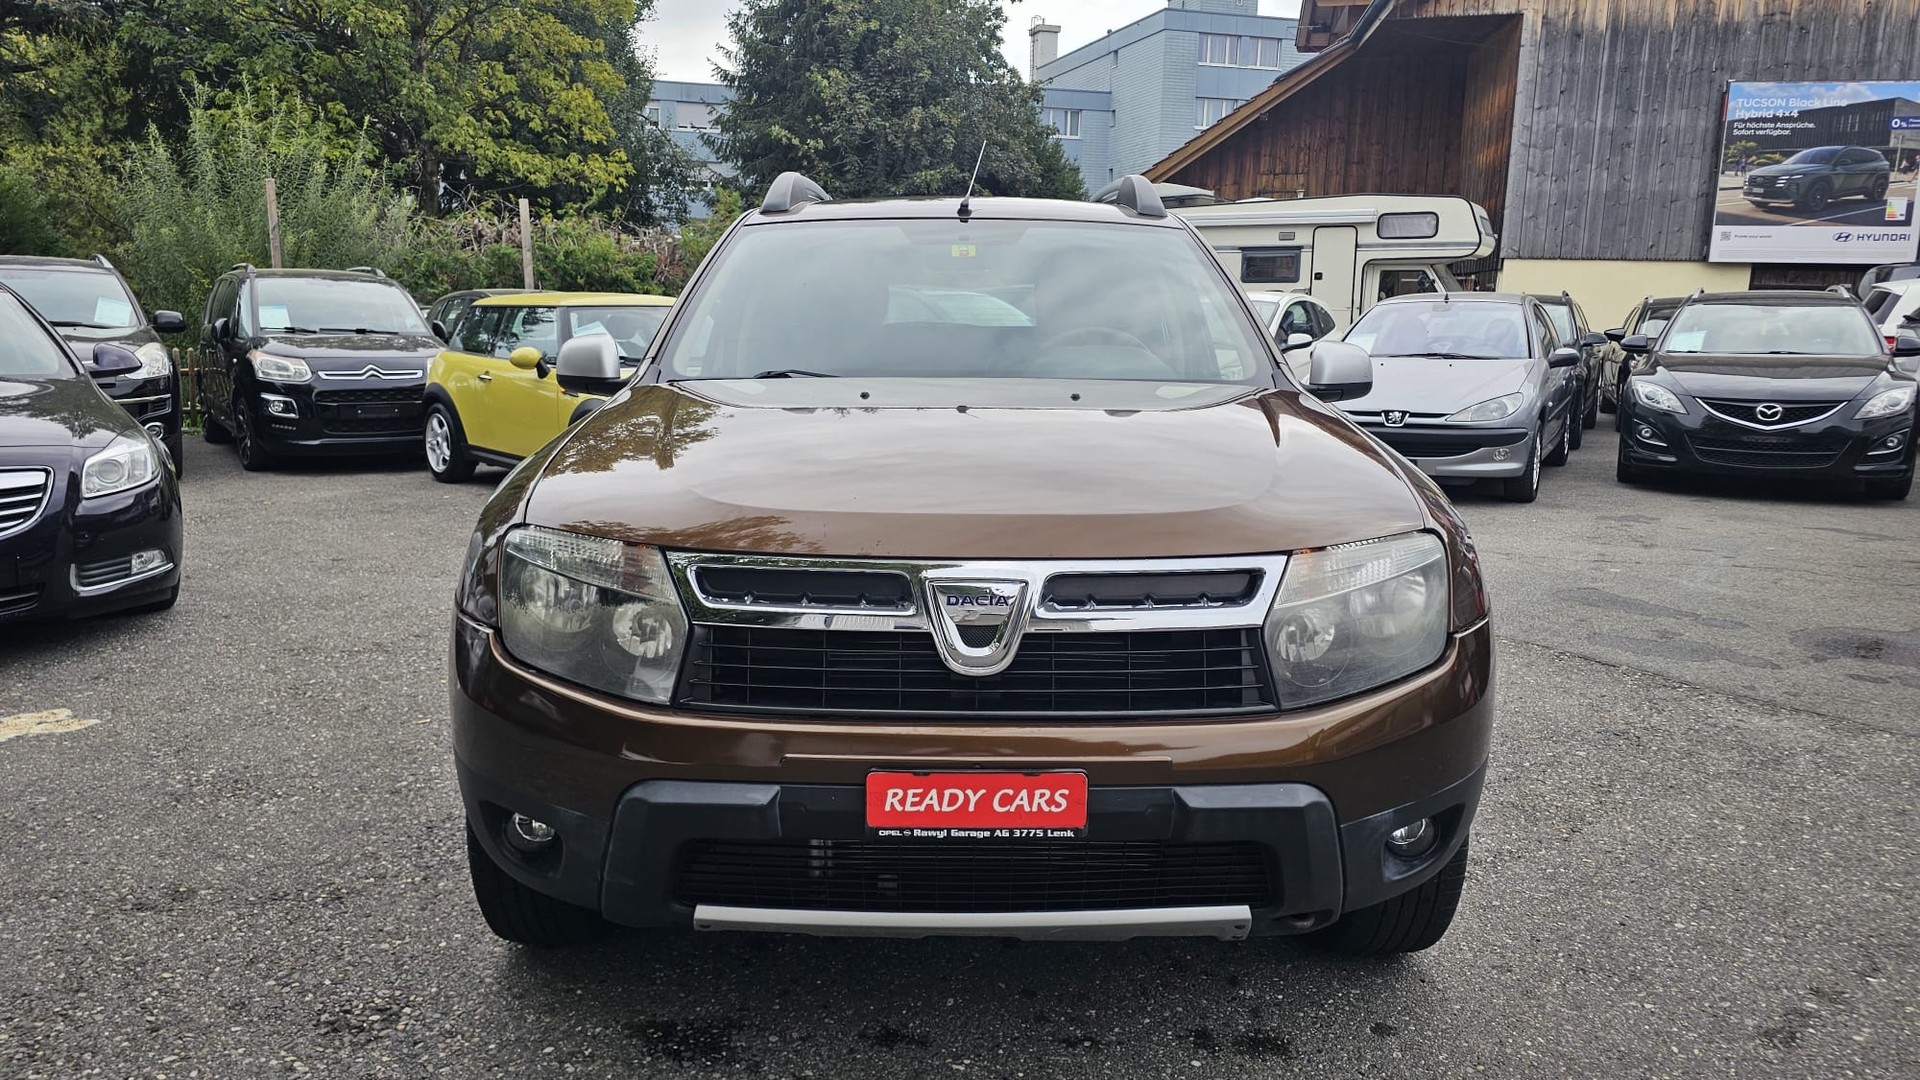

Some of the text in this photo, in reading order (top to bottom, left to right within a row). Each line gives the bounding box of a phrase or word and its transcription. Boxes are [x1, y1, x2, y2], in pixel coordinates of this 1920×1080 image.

[1737, 98, 1786, 107] TUCSON
[1789, 98, 1819, 107] Black
[1735, 109, 1799, 120] Hybrid 4x4
[1856, 233, 1911, 242] HYUNDAI
[946, 595, 1009, 607] DACIA
[884, 788, 1070, 813] READY CARS
[913, 829, 947, 839] Rawyl
[950, 829, 991, 839] Garage
[993, 829, 1010, 837] AG
[1013, 829, 1044, 837] 3775
[1047, 829, 1075, 837] Lenk
